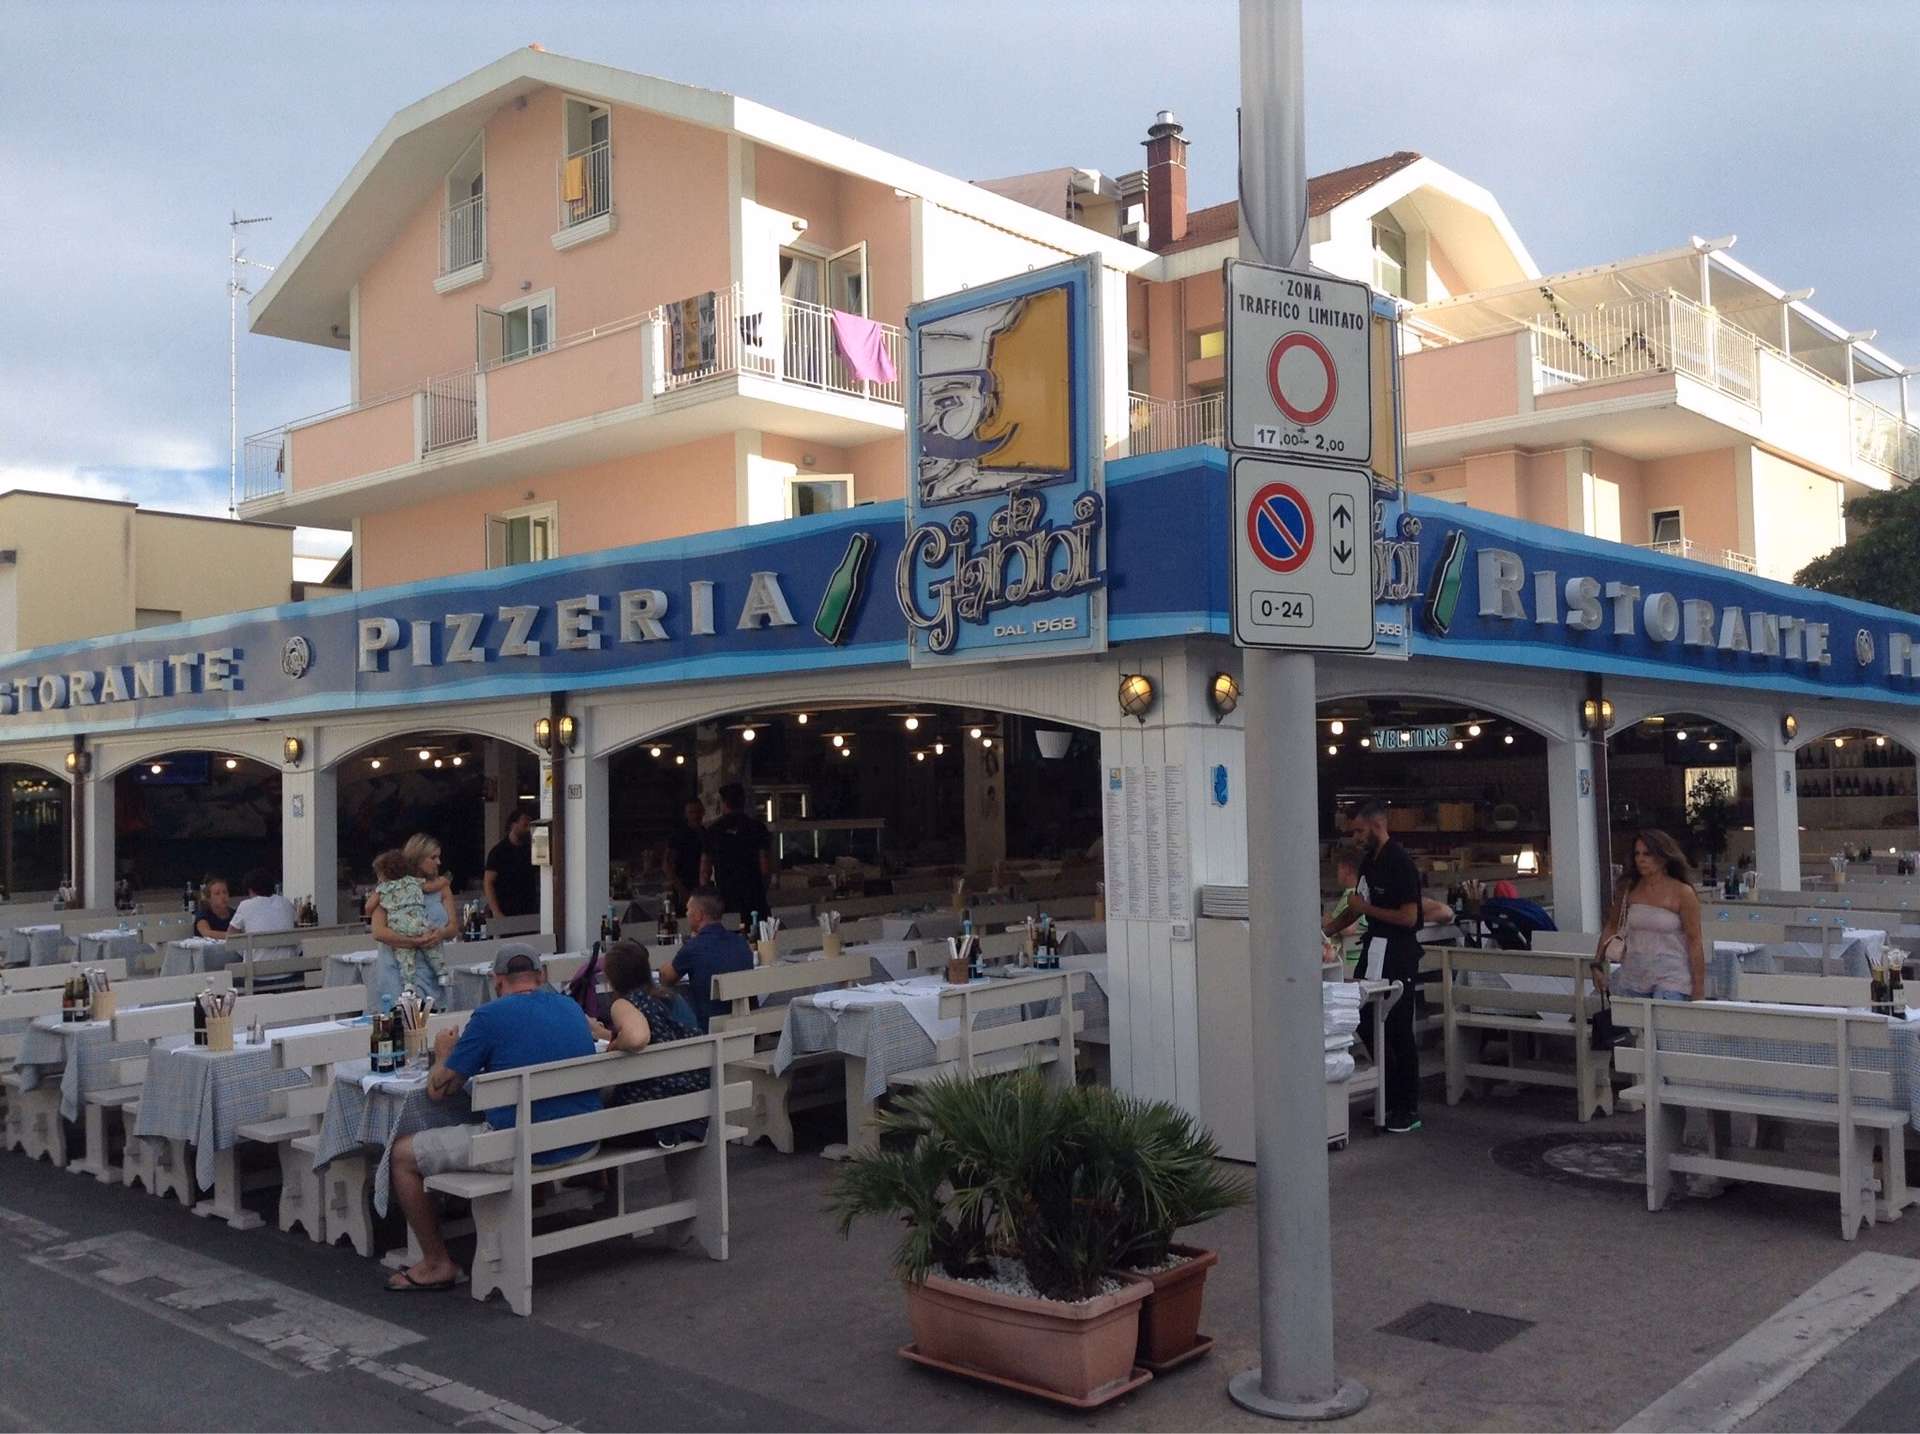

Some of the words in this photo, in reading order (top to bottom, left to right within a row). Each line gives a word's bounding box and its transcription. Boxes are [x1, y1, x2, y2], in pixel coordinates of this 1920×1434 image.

[1287, 280, 1321, 301] ZONA
[1239, 294, 1300, 320] TRAFFICO
[1309, 307, 1364, 330] LIMITATO
[895, 496, 1101, 651] Gianni
[358, 571, 798, 672] PIZZERIA
[1261, 600, 1304, 619] 0-24
[1477, 547, 1832, 667] RISTORANTE
[994, 625, 1026, 637] DAL
[1031, 617, 1076, 633] 1968
